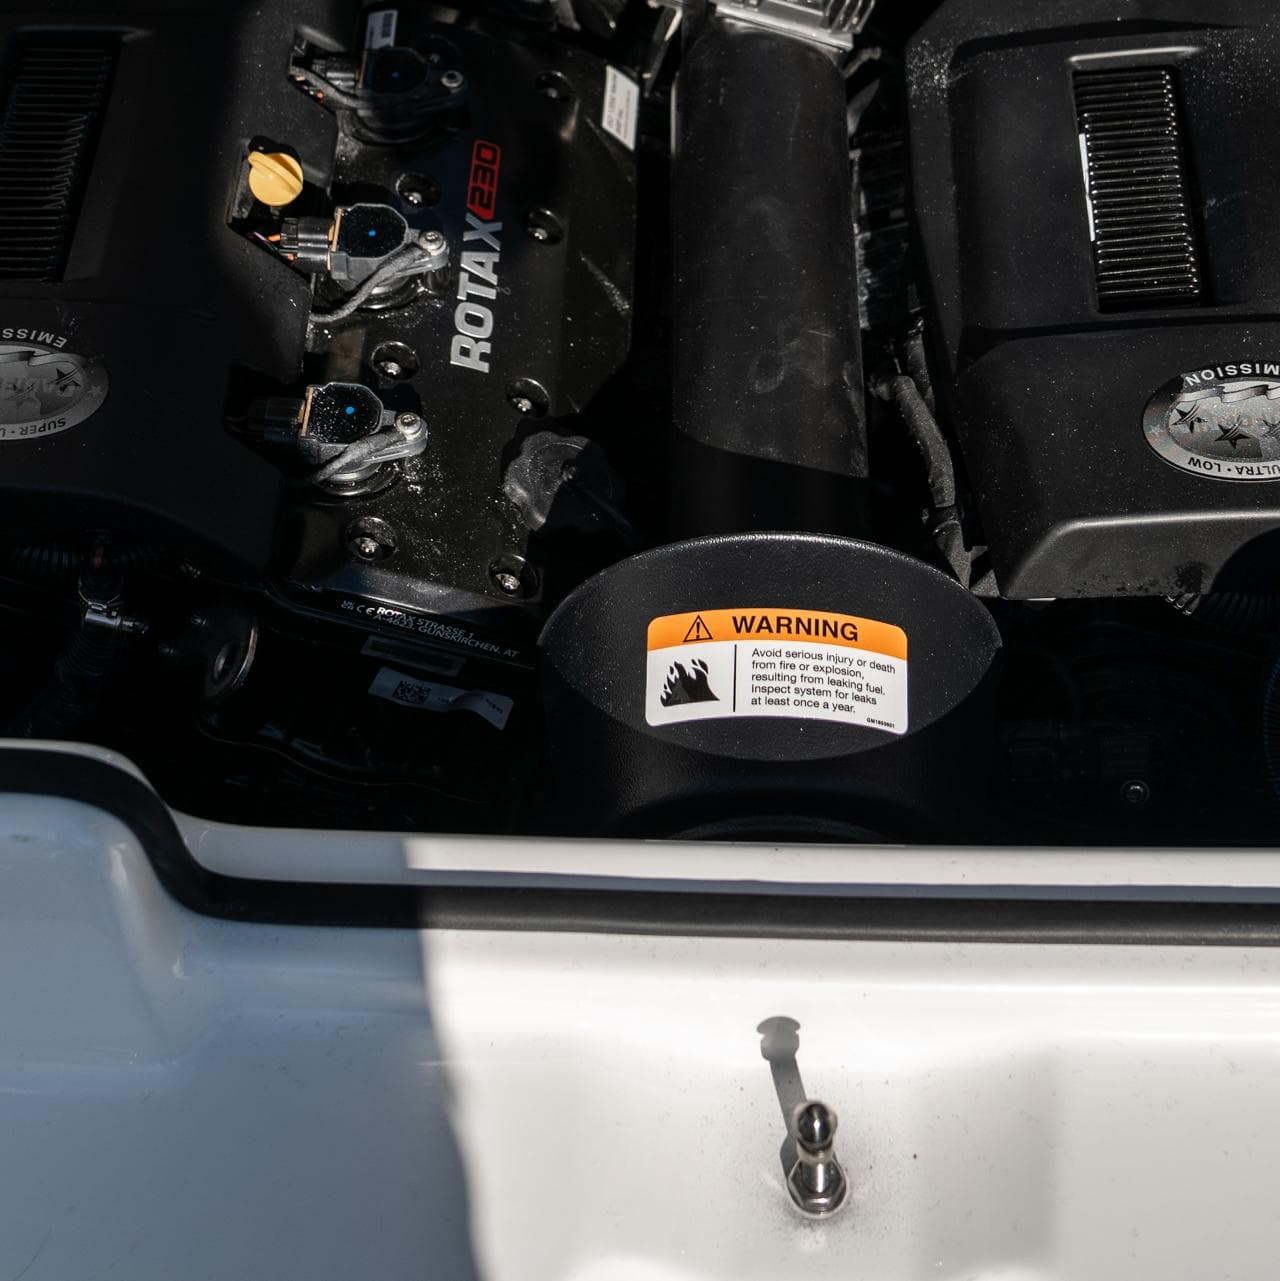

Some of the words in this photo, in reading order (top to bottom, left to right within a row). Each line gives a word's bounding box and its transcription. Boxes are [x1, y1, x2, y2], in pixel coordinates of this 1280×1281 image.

[466, 137, 503, 221] 230
[450, 212, 503, 374] ROTAX
[19, 417, 67, 436] SUPER
[1188, 456, 1222, 473] LOW
[376, 607, 415, 624] ROTAX
[416, 618, 466, 636] STRASSE
[732, 615, 859, 642] WARNING
[752, 648, 782, 658] Avoid
[785, 650, 823, 661] serious
[826, 652, 854, 666] injury
[857, 659, 867, 667] or
[869, 660, 896, 674] death
[752, 660, 776, 670] from
[779, 661, 796, 670] fire
[799, 663, 810, 671] or
[813, 664, 865, 680] explosion,
[751, 672, 797, 684] resulting
[800, 675, 824, 685] from
[827, 677, 863, 692] leaking
[865, 683, 886, 695] fuel.
[751, 685, 791, 696] Inspect
[794, 687, 832, 697] system
[835, 690, 849, 700] for
[852, 692, 877, 705] leaks
[751, 697, 762, 705] at
[765, 696, 790, 706] least
[793, 699, 820, 708] once
[822, 701, 829, 709] a
[832, 703, 856, 713] year.
